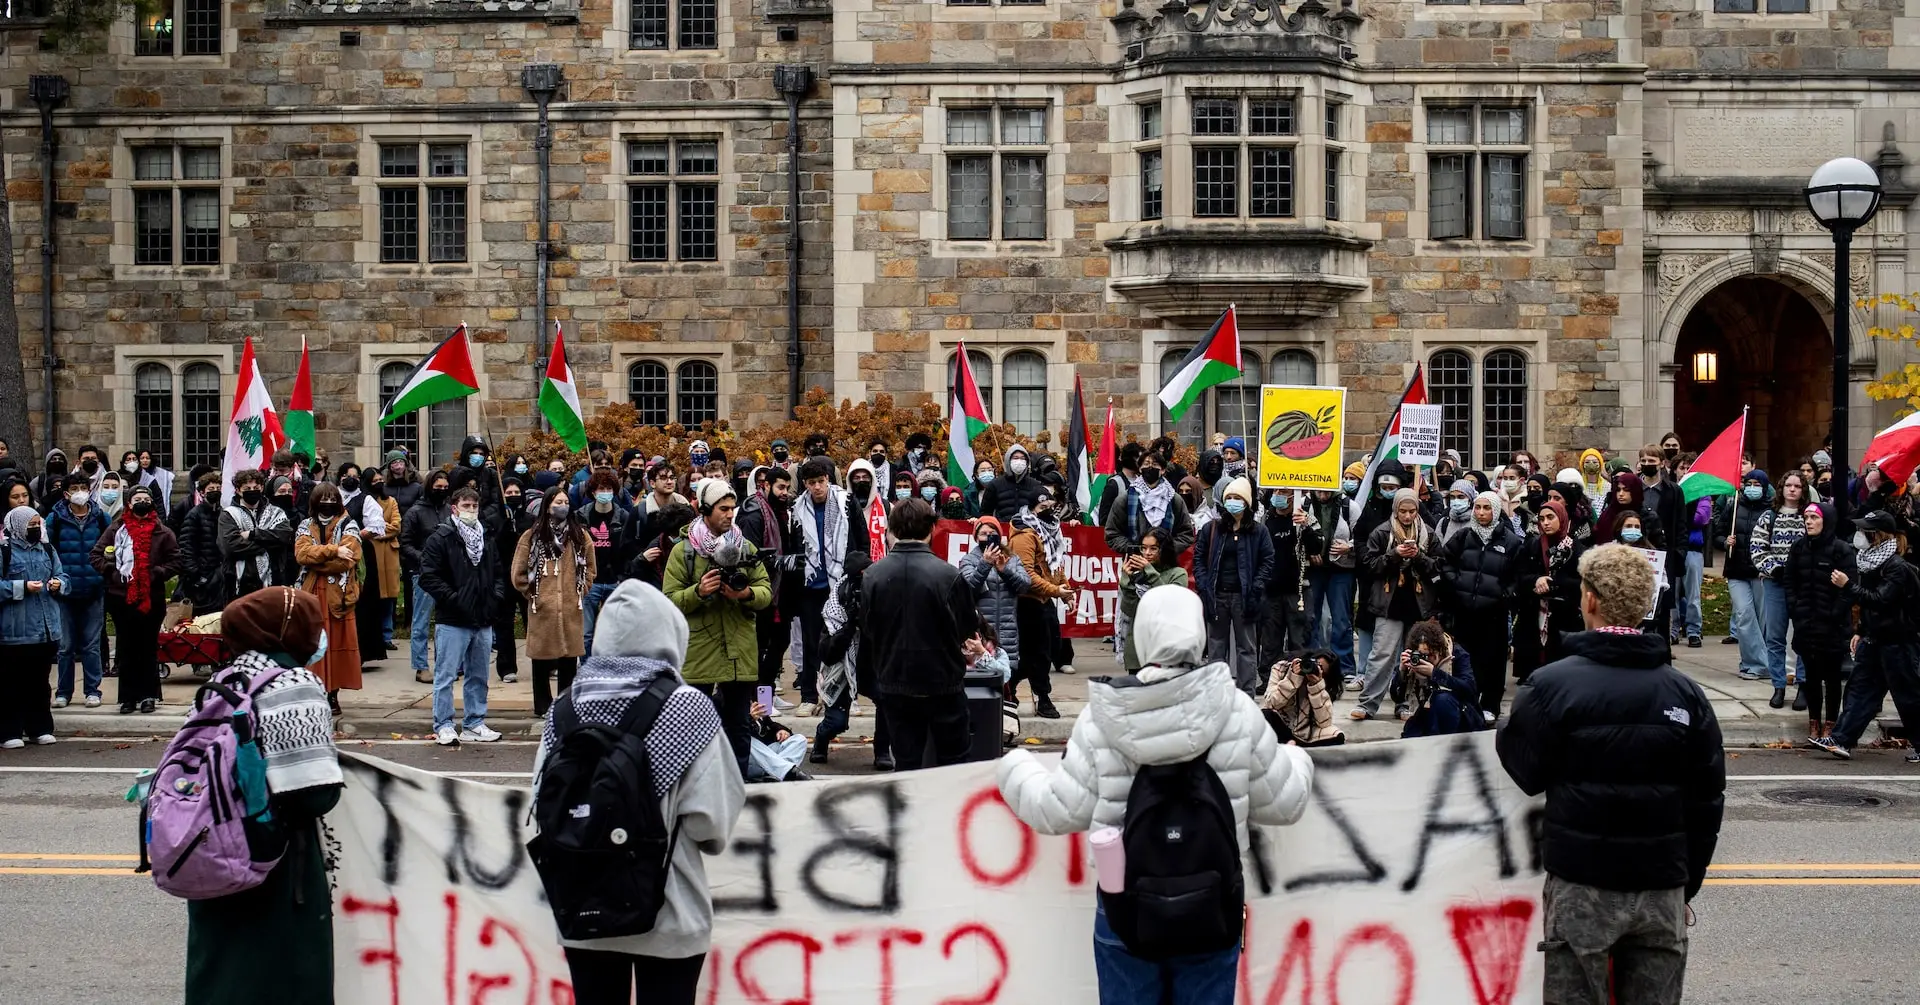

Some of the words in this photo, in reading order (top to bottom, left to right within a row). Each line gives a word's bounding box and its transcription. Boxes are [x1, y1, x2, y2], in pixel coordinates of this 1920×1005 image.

[1401, 426, 1418, 434] FROM
[1419, 427, 1439, 435] BEIRUT
[1400, 441, 1437, 449] OCCUPATION
[1289, 473, 1332, 482] PALESTINA
[1168, 830, 1180, 840] alo
